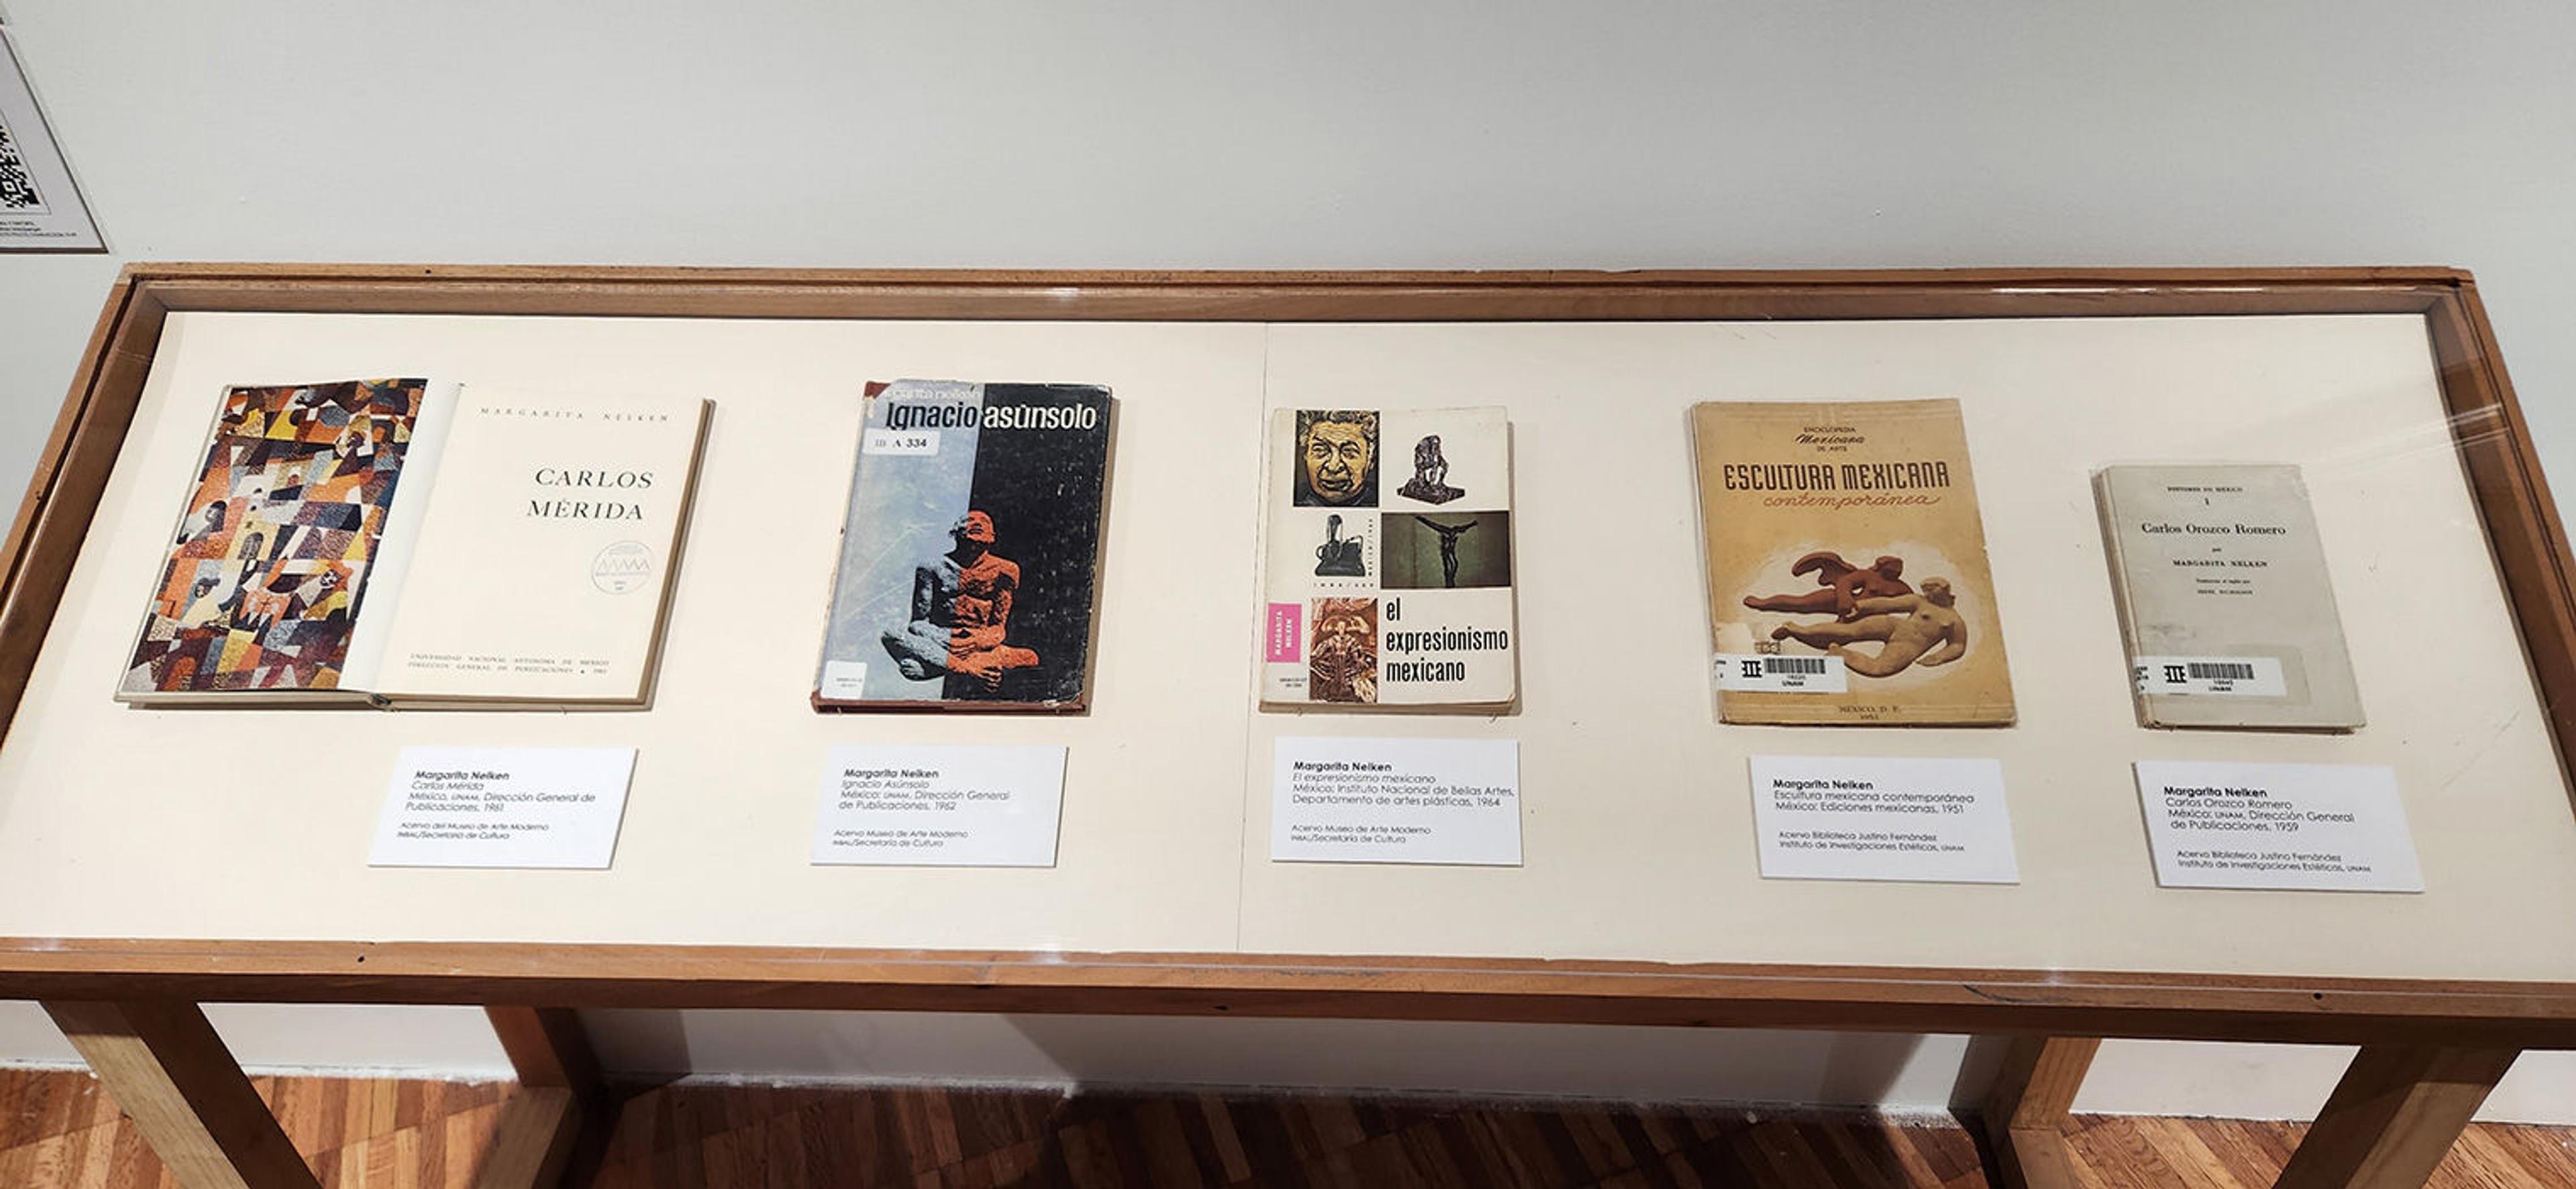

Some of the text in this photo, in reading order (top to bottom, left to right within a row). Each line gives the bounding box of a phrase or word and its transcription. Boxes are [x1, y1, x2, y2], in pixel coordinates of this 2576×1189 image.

[481, 408, 668, 422] MARGARITA NELKEN
[886, 401, 1097, 431] Ignacio asúnsolo
[907, 439, 927, 448] 334
[1795, 433, 1865, 444] Mexicana
[535, 467, 654, 490] CARLOS
[1723, 461, 1950, 491] ESCULTURA MEXICANA
[527, 498, 644, 520] MÉRIDA
[2141, 523, 2286, 535] Carlos Orozco Romero
[2172, 559, 2226, 567] MARGARITA
[1387, 597, 1401, 621] el
[1386, 626, 1509, 654] expresionismo
[1386, 657, 1465, 683] mexicano
[1293, 762, 1392, 772] Margarita Nelken
[415, 771, 510, 781] Margarita Nelken
[844, 769, 939, 779] Margarita Nelken
[1293, 773, 1436, 785] El expresionismo mexicano
[411, 781, 484, 791] Carlos Mérida
[841, 779, 930, 790] Ignacio Asúnsolo
[1338, 784, 1379, 793] Instituto
[1381, 785, 1430, 795] Nacional
[1433, 785, 1448, 795] de
[1450, 786, 1481, 795] Bellas
[1484, 787, 1515, 797] Artes,
[1773, 779, 1874, 791] Margarita Nelken
[484, 792, 533, 802] Dirección
[536, 792, 580, 802] General
[581, 793, 595, 802] de
[841, 790, 879, 799] México:
[915, 790, 965, 800] Dirección
[967, 791, 1010, 800] General
[1774, 791, 1975, 804] Escultura mexicana contemporánea
[2163, 786, 2267, 798] Margarita Nelken
[405, 802, 504, 812] Publicaciones, 1961
[839, 801, 957, 811] de Publicaciones, 1962
[1293, 795, 1373, 805] Departamento
[1376, 795, 1391, 805] de
[1393, 796, 1419, 805] artes
[1478, 797, 1501, 807] 1964
[2165, 797, 2292, 809] Carlos Orozco Romero
[1821, 802, 1873, 812] Ediciones
[1876, 803, 1939, 814] mexicanas,
[1942, 805, 1964, 814] 1951
[2249, 810, 2304, 821] Dirección
[2306, 811, 2355, 823] General
[1291, 824, 1431, 834] Acervo Museo de Arte Moderno
[2171, 820, 2299, 832] de Publicaciones, 1959
[833, 830, 864, 838] Acervo
[867, 830, 894, 838] Museo
[896, 830, 908, 838] de
[910, 830, 927, 838] Arte
[1360, 835, 1372, 843] de
[1375, 835, 1406, 843] Cultura
[1779, 831, 1937, 842] Acervo Biblioteca Justino Fernández
[899, 839, 911, 847] de
[913, 839, 943, 848] Cultura
[1780, 840, 1812, 849] Instituto
[1815, 841, 1827, 850] de
[1829, 841, 1897, 852] Investigaciones
[2177, 850, 2341, 862] Acervo Biblioteca Justino Fernández
[2178, 860, 2213, 868] Instituto
[2215, 860, 2228, 869] de
[2231, 861, 2301, 871] Investigaciones
